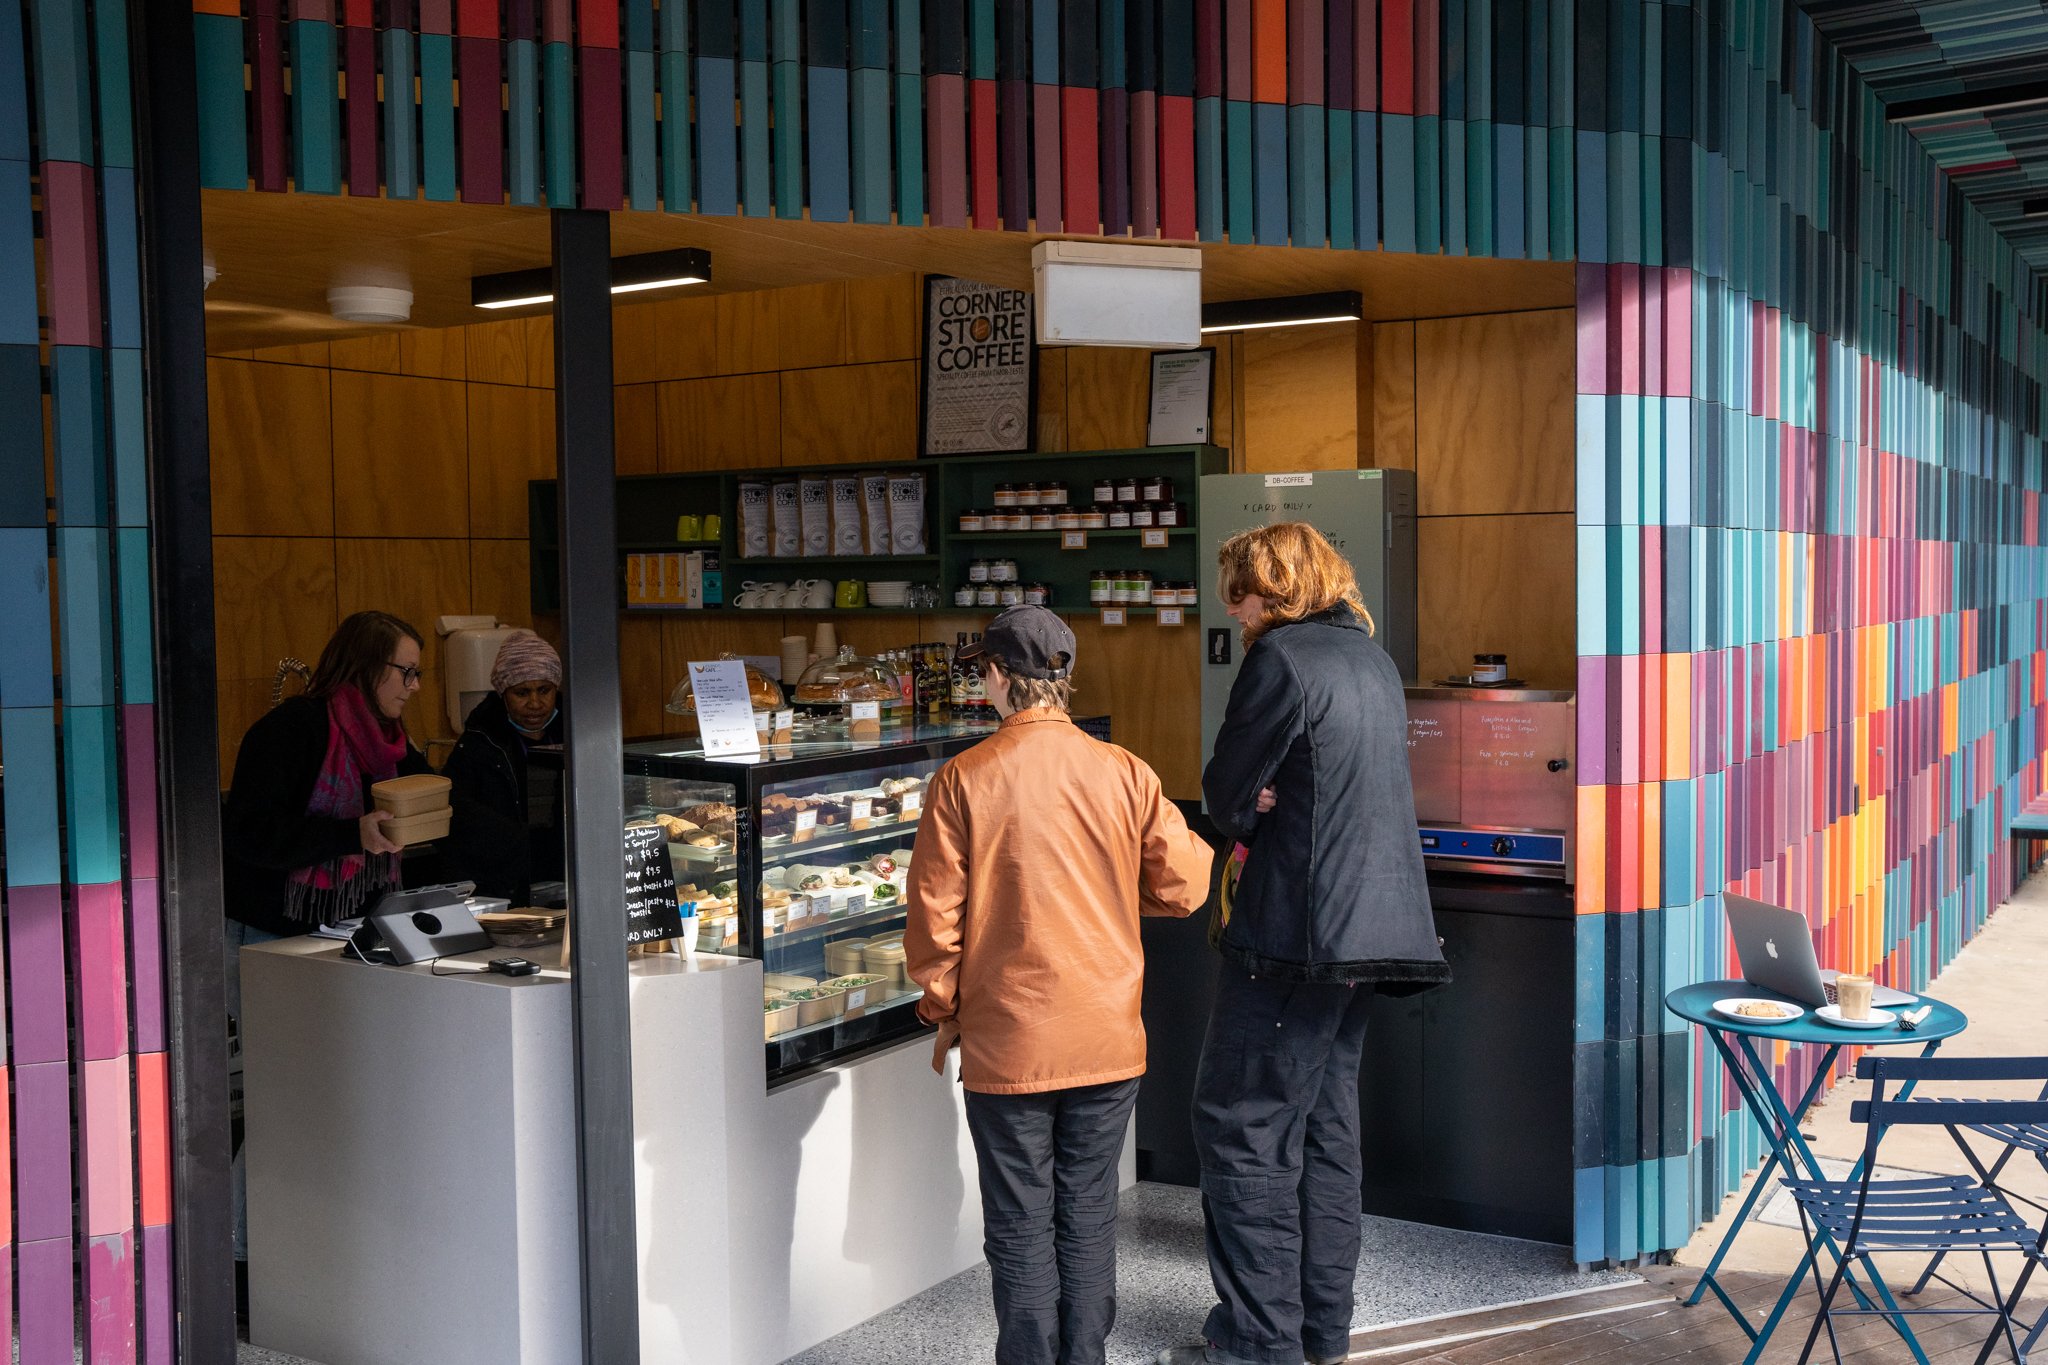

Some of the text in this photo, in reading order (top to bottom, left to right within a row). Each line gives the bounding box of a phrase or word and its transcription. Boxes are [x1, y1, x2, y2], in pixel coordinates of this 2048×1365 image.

[939, 290, 1026, 317] CORNER
[938, 312, 1025, 346] STORE
[937, 341, 1024, 372] COFFEE
[1272, 476, 1305, 484] DB-COFFEE
[1252, 503, 1277, 512] CARD
[1283, 502, 1304, 511] ONLY
[640, 847, 660, 862] $9.5
[625, 885, 643, 894] heese
[627, 927, 663, 941] RD ONLY
